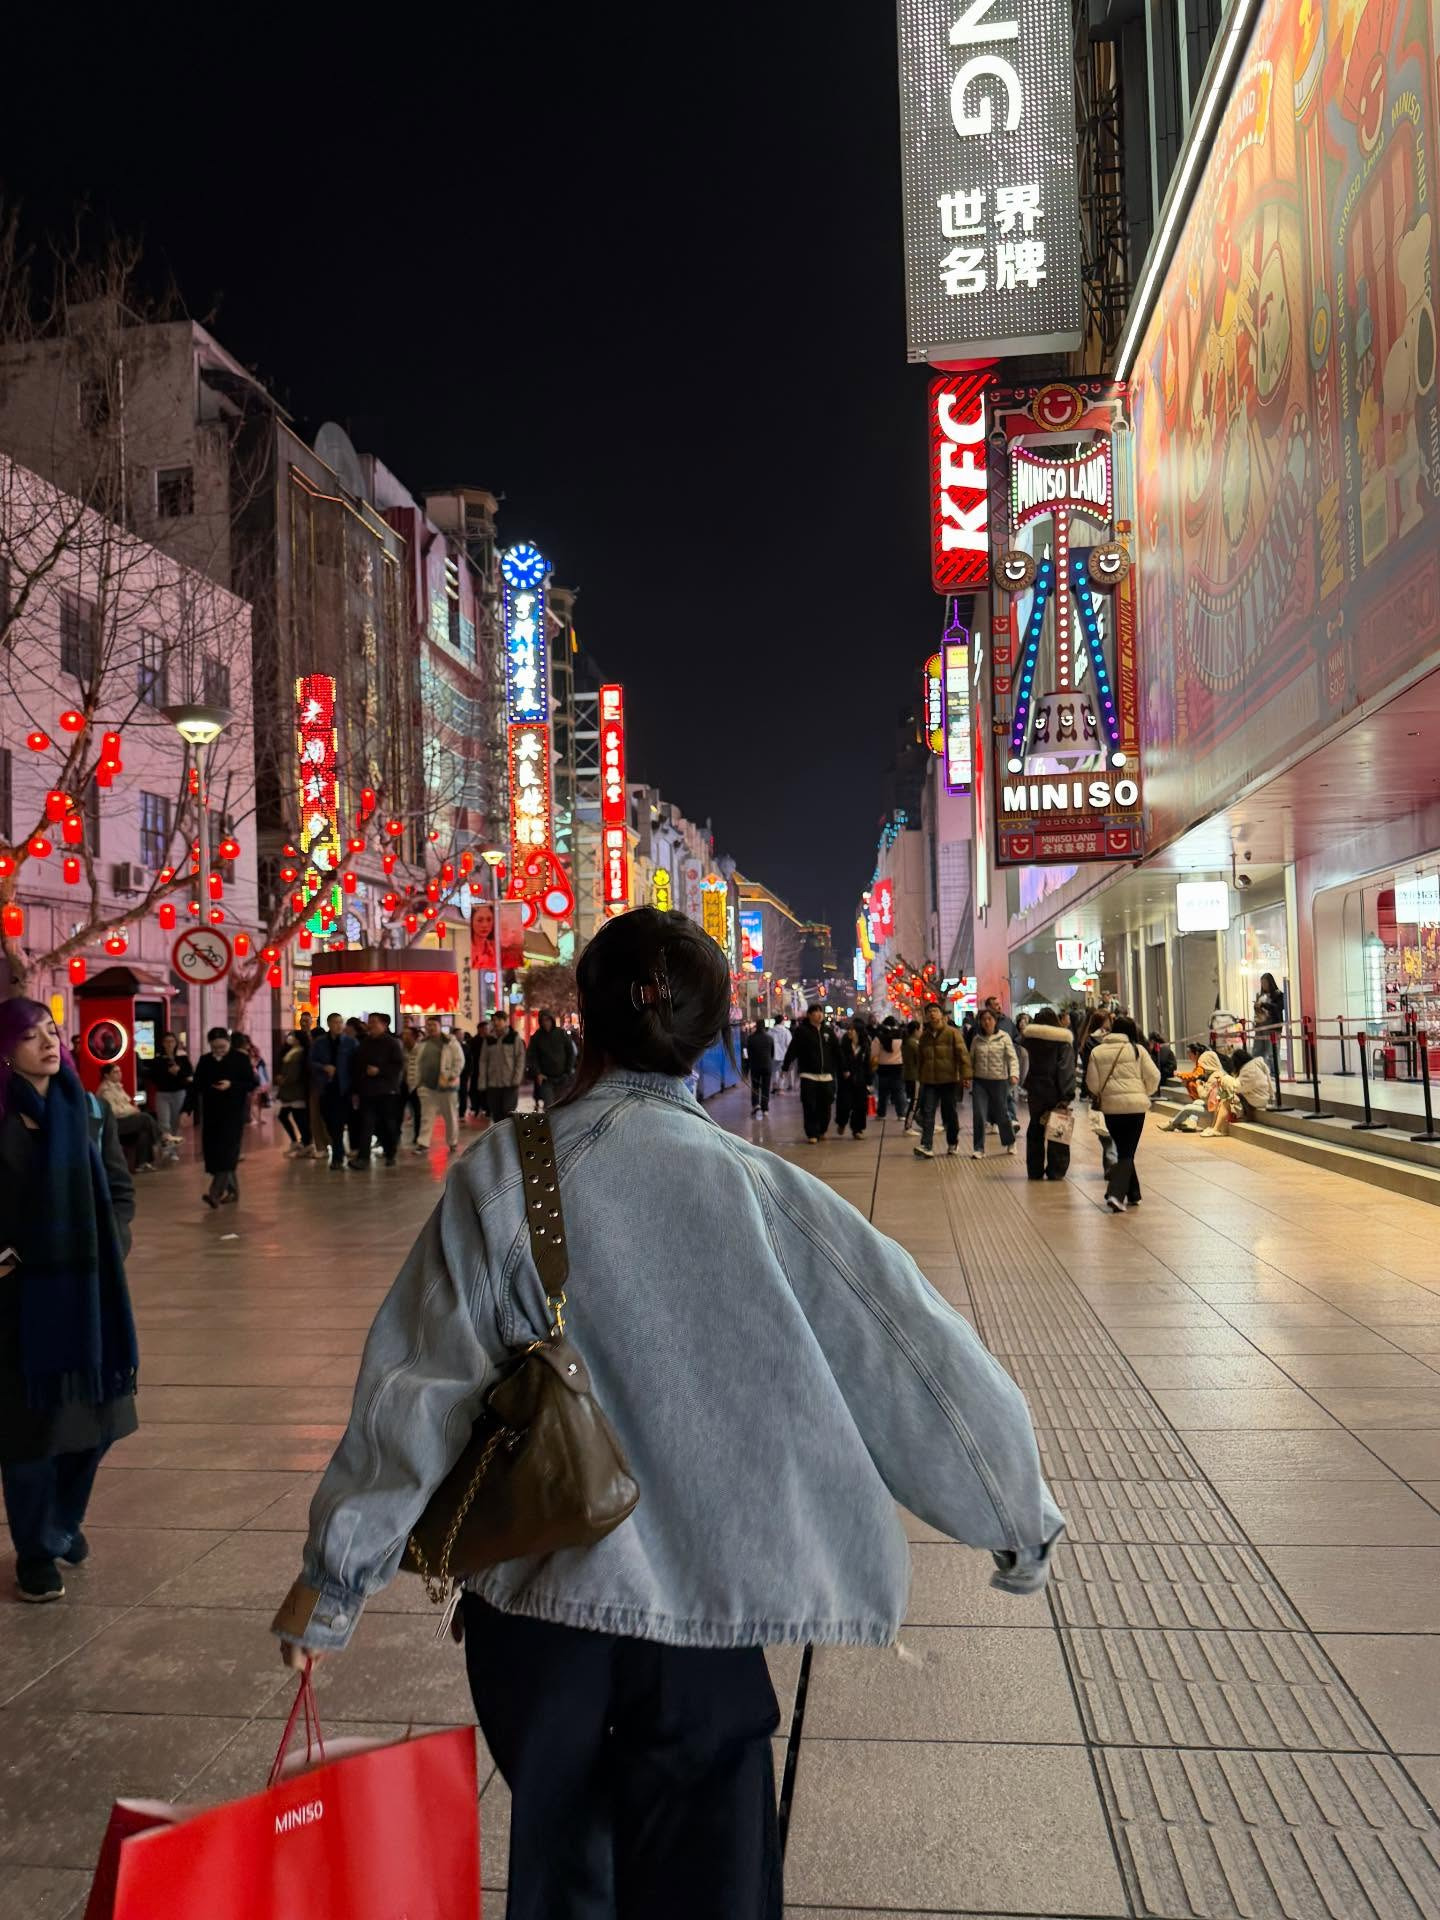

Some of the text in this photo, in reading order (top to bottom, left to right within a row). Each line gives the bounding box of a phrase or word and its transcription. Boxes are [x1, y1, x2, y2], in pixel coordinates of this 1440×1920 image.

[936, 184, 1044, 239] 世界
[938, 240, 1047, 296] 名牌
[938, 391, 989, 553] KFC
[1017, 455, 1108, 507] MINISO LAND
[1003, 780, 1138, 812] MINISO
[1041, 833, 1097, 844] MINISO LAND
[1042, 842, 1097, 855] 全球壹号店
[274, 1800, 324, 1835] MINISO
